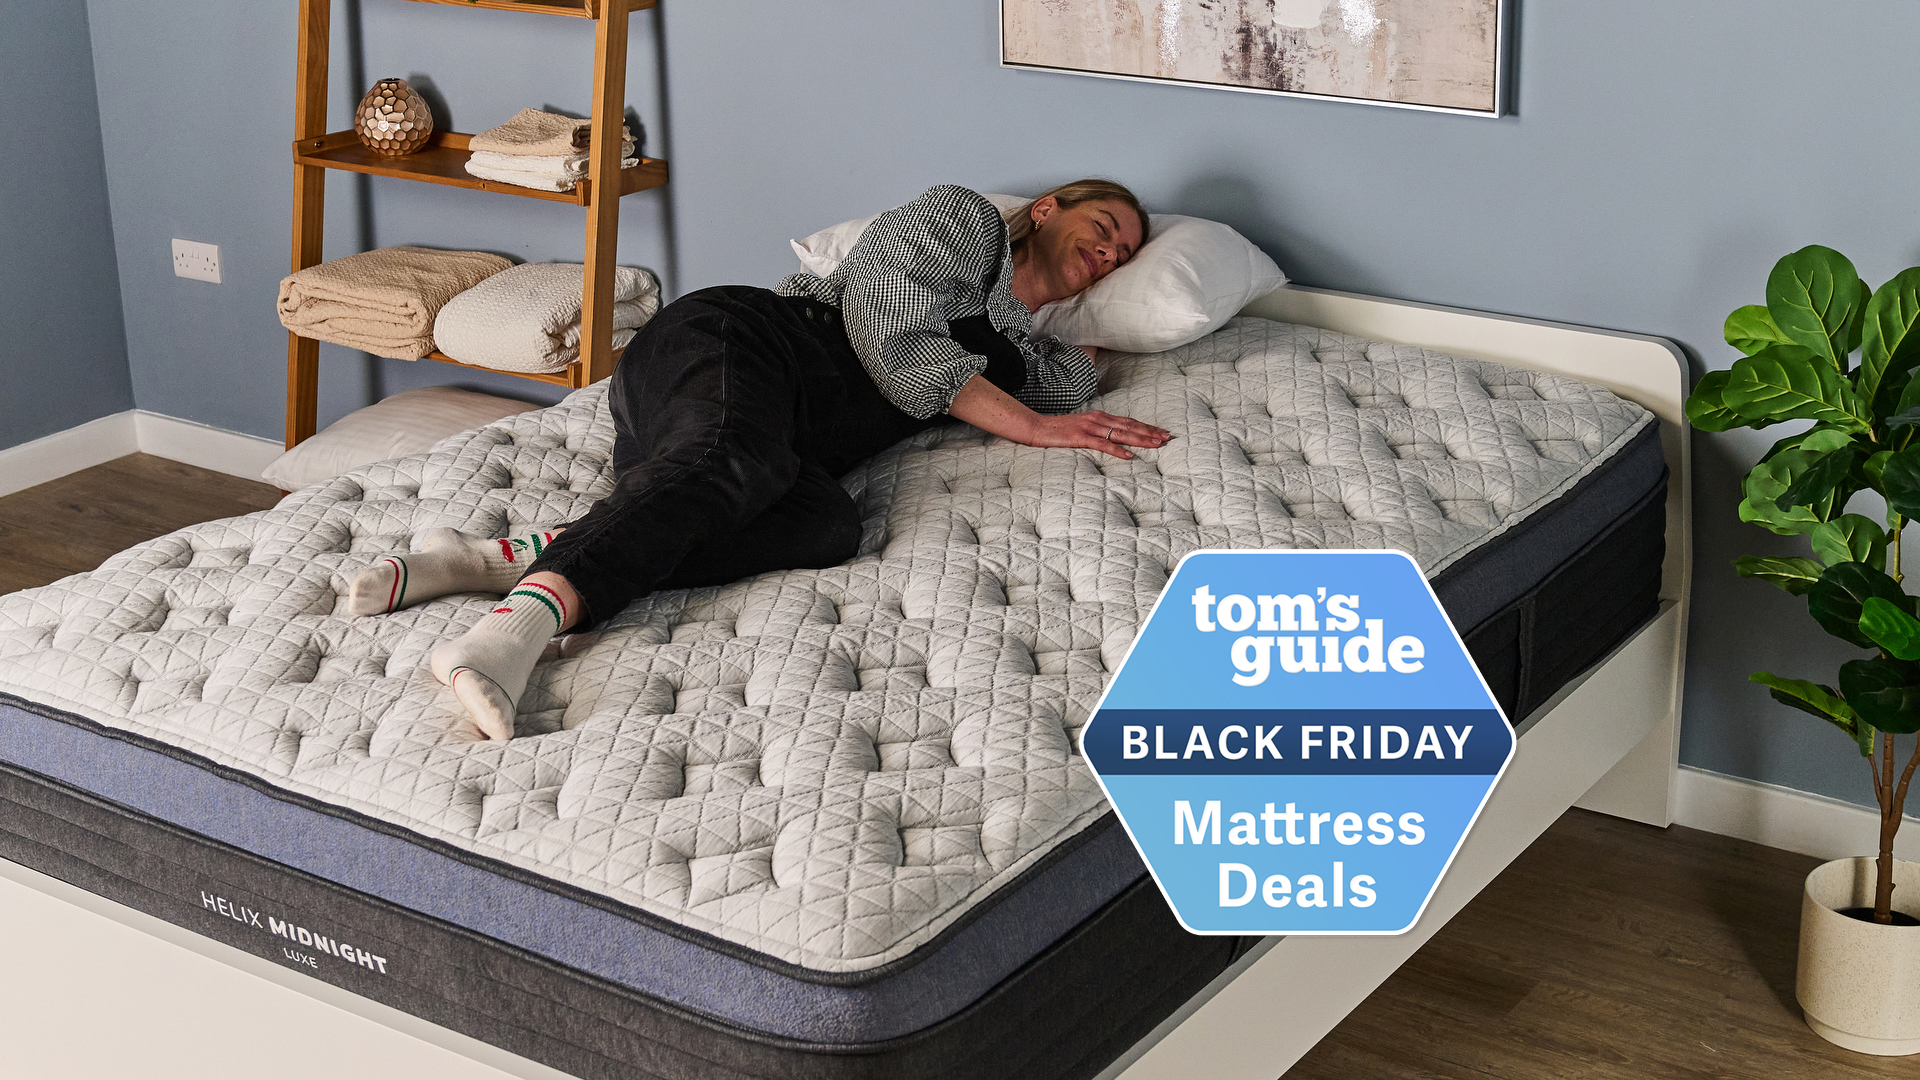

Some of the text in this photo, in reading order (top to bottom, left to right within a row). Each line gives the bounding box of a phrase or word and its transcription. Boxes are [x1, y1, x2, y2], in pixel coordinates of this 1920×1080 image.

[201, 890, 387, 974] HELIX MIDNIGHT
[283, 947, 318, 969] LUXE
